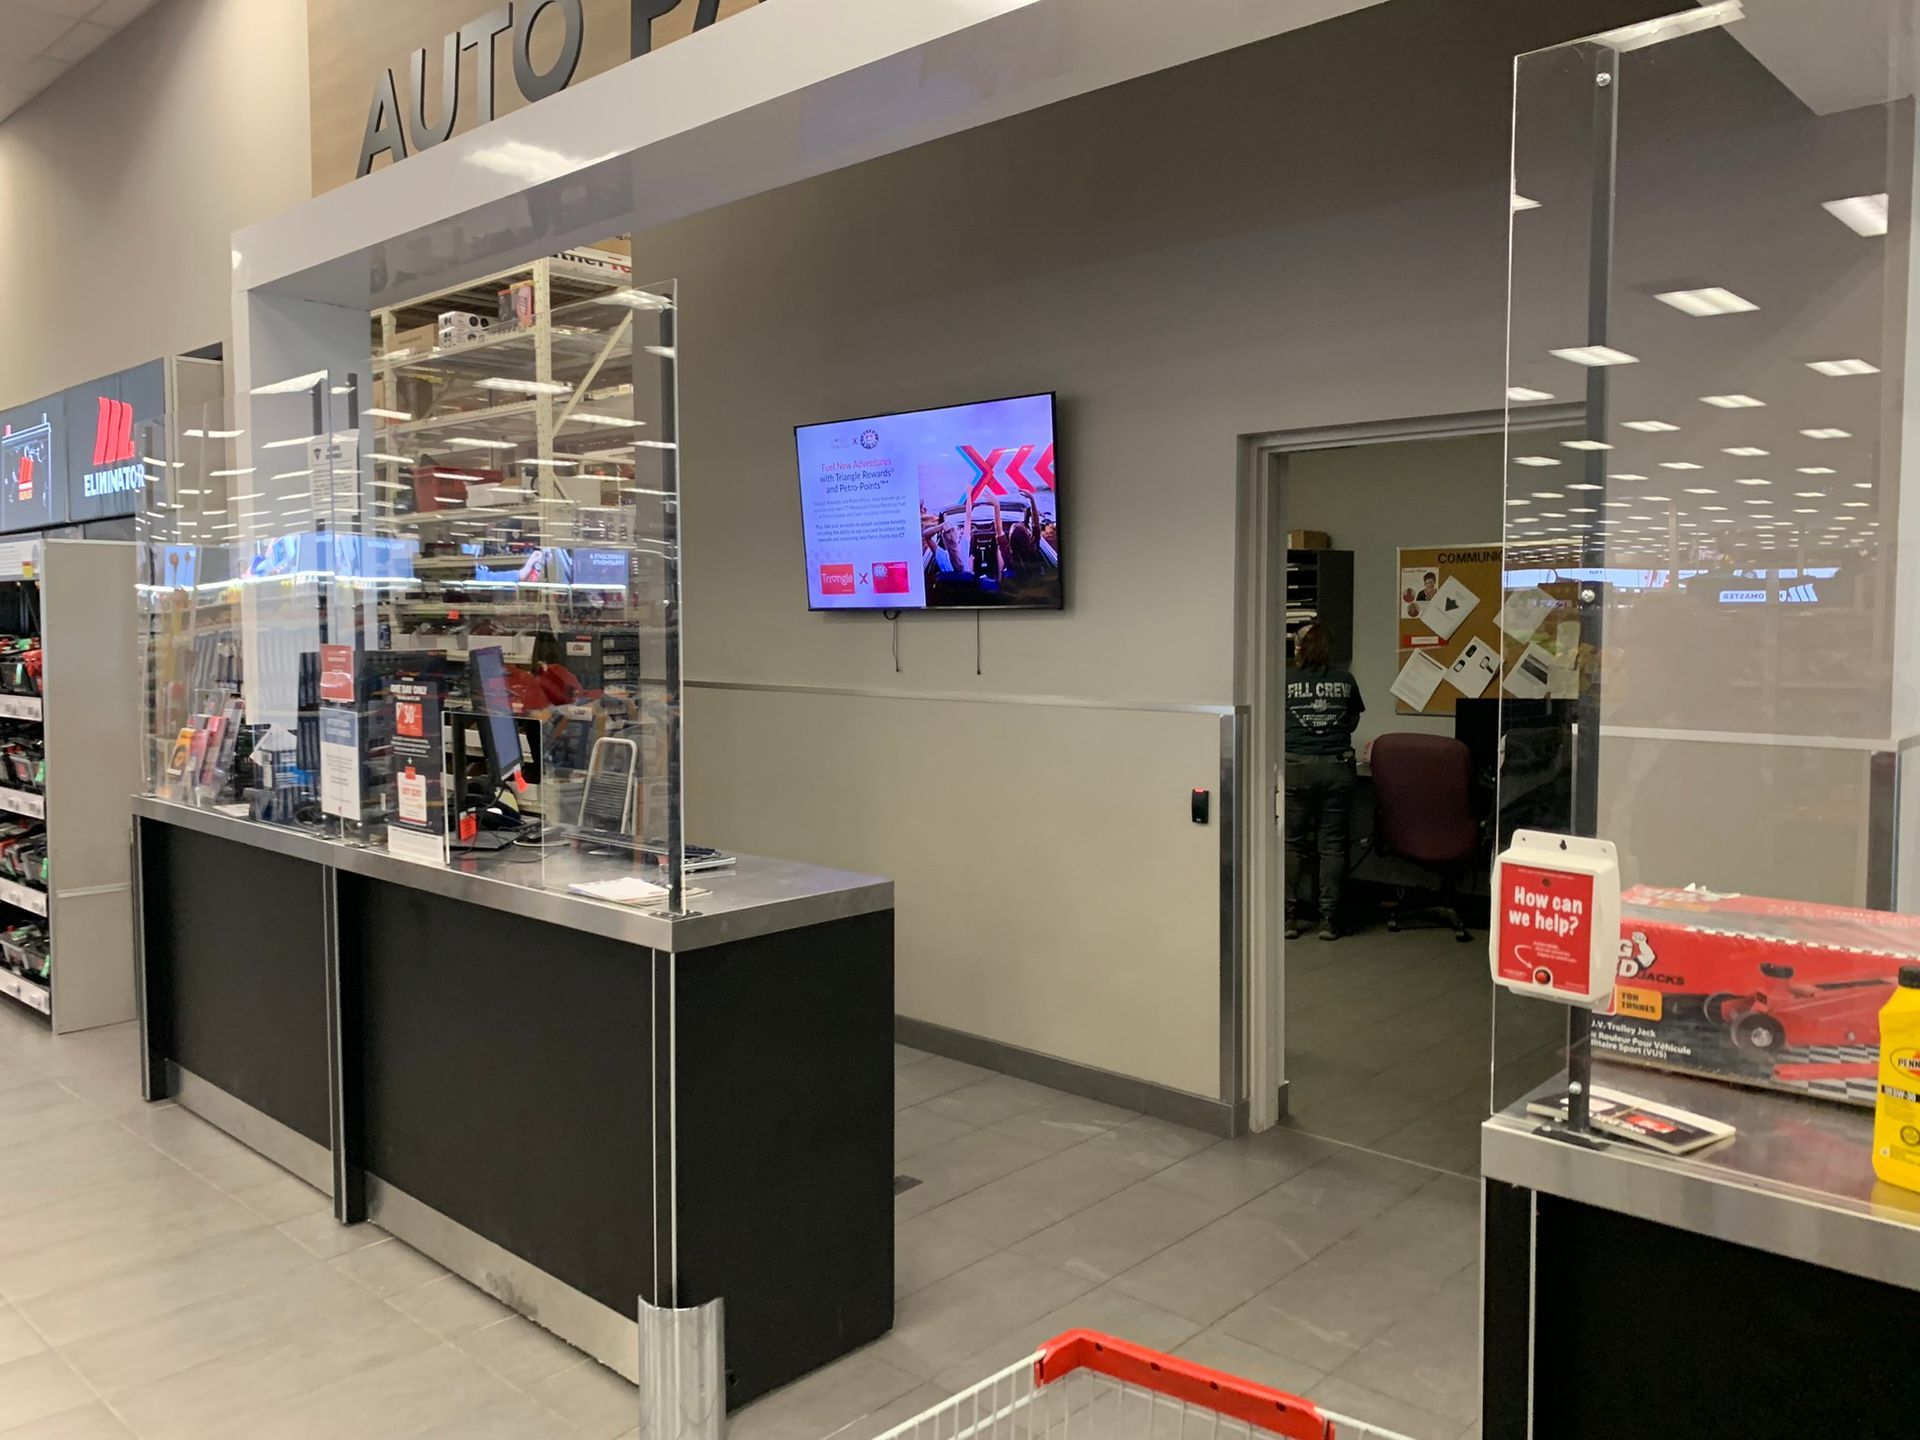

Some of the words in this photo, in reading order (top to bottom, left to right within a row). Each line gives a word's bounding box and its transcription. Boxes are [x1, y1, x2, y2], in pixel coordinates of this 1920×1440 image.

[355, 0, 584, 179] AUTO
[822, 463, 836, 472] Fuel
[837, 461, 852, 470] New
[853, 458, 892, 468] Adventures
[84, 464, 145, 497] ELIMINATOR
[819, 474, 834, 483] with
[836, 471, 861, 482] Triangle
[826, 484, 838, 493] and
[822, 571, 854, 586] Triangle
[1287, 682, 1313, 698] FILL
[1315, 682, 1352, 698] CREW
[1514, 885, 1549, 909] How
[1552, 896, 1583, 915] can
[1509, 910, 1530, 927] we
[1535, 909, 1579, 937] help?
[1640, 972, 1685, 986] JACKS
[1621, 992, 1639, 1001] TON
[1621, 1001, 1656, 1014] TONNES
[1607, 1021, 1636, 1035] Trolley
[1637, 1024, 1656, 1038] Jack
[1598, 1031, 1631, 1044] Rouleur
[1632, 1037, 1653, 1048] Pour
[1654, 1040, 1692, 1055] Véhicule
[1619, 1043, 1642, 1055] Sport
[1643, 1046, 1667, 1059] (VUS)
